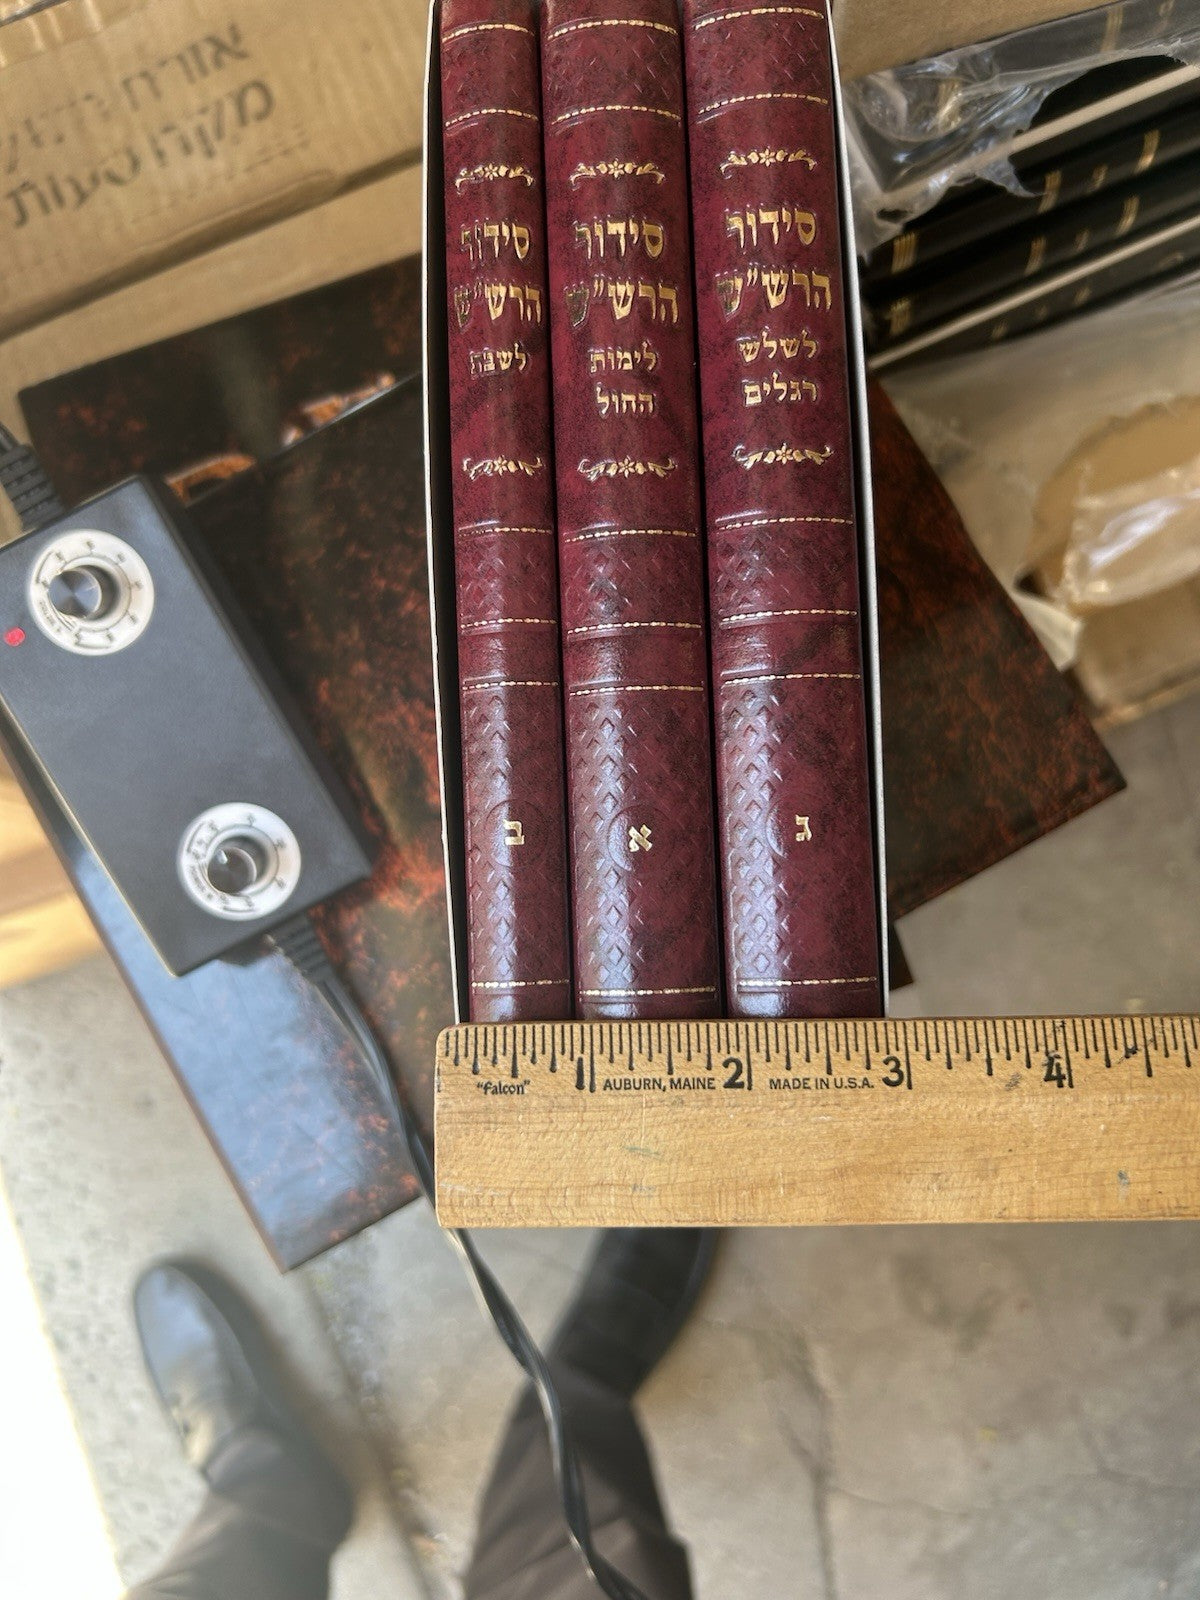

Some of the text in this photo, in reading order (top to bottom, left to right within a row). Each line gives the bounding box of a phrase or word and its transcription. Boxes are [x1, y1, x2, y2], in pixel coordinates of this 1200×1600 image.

[461, 221, 530, 262] סידור
[576, 219, 664, 260] סידור
[727, 208, 816, 249] סידור
[716, 267, 832, 314] הרש"ש
[470, 343, 526, 374] לשבת
[590, 341, 657, 373] לימות
[739, 329, 817, 363] לשלש
[597, 386, 654, 415] החול
[744, 372, 817, 407] רגלים
[503, 820, 525, 845] ב
[628, 824, 652, 851] א
[795, 814, 811, 841] ג
[603, 1077, 716, 1092] AUBURN, MAINE
[722, 1057, 744, 1089] 2
[769, 1077, 875, 1090] MADE IN U.S.A.
[882, 1056, 904, 1087] 3
[1043, 1055, 1066, 1088] 4
